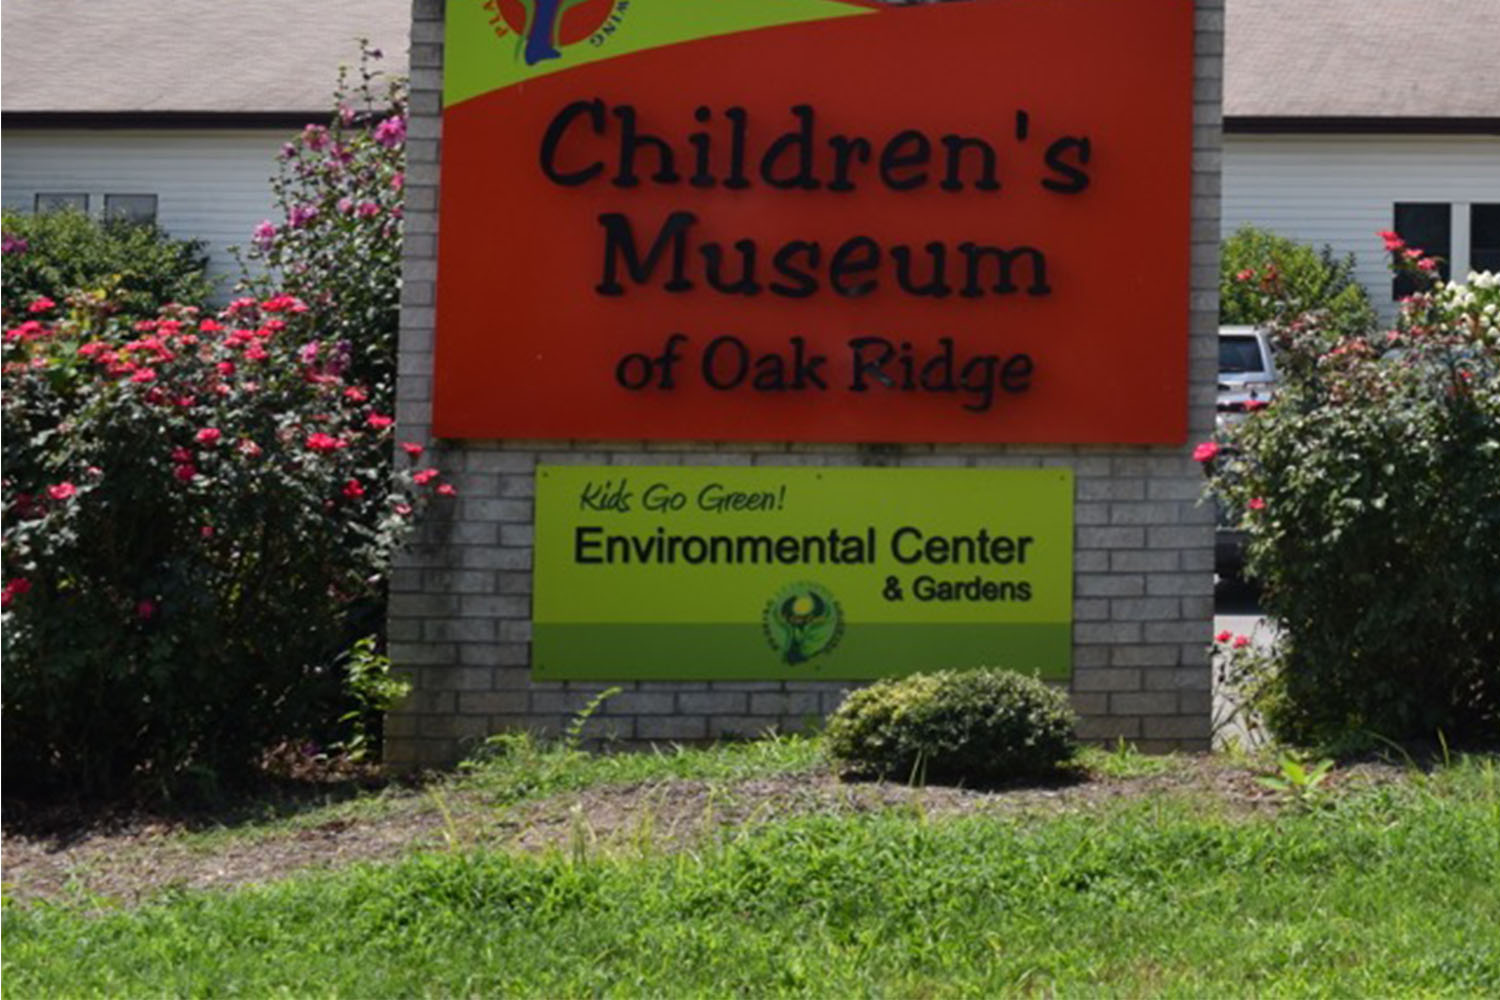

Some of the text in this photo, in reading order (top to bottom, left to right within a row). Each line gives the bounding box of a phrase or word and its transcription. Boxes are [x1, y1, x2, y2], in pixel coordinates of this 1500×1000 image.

[539, 98, 1092, 195] Children's
[595, 211, 1052, 298] Museum
[615, 332, 1034, 413] of Oak Ridge
[579, 479, 787, 513] Kids Go Green!
[573, 525, 1033, 565] Environmental Center
[882, 575, 1032, 602] & Gardens
